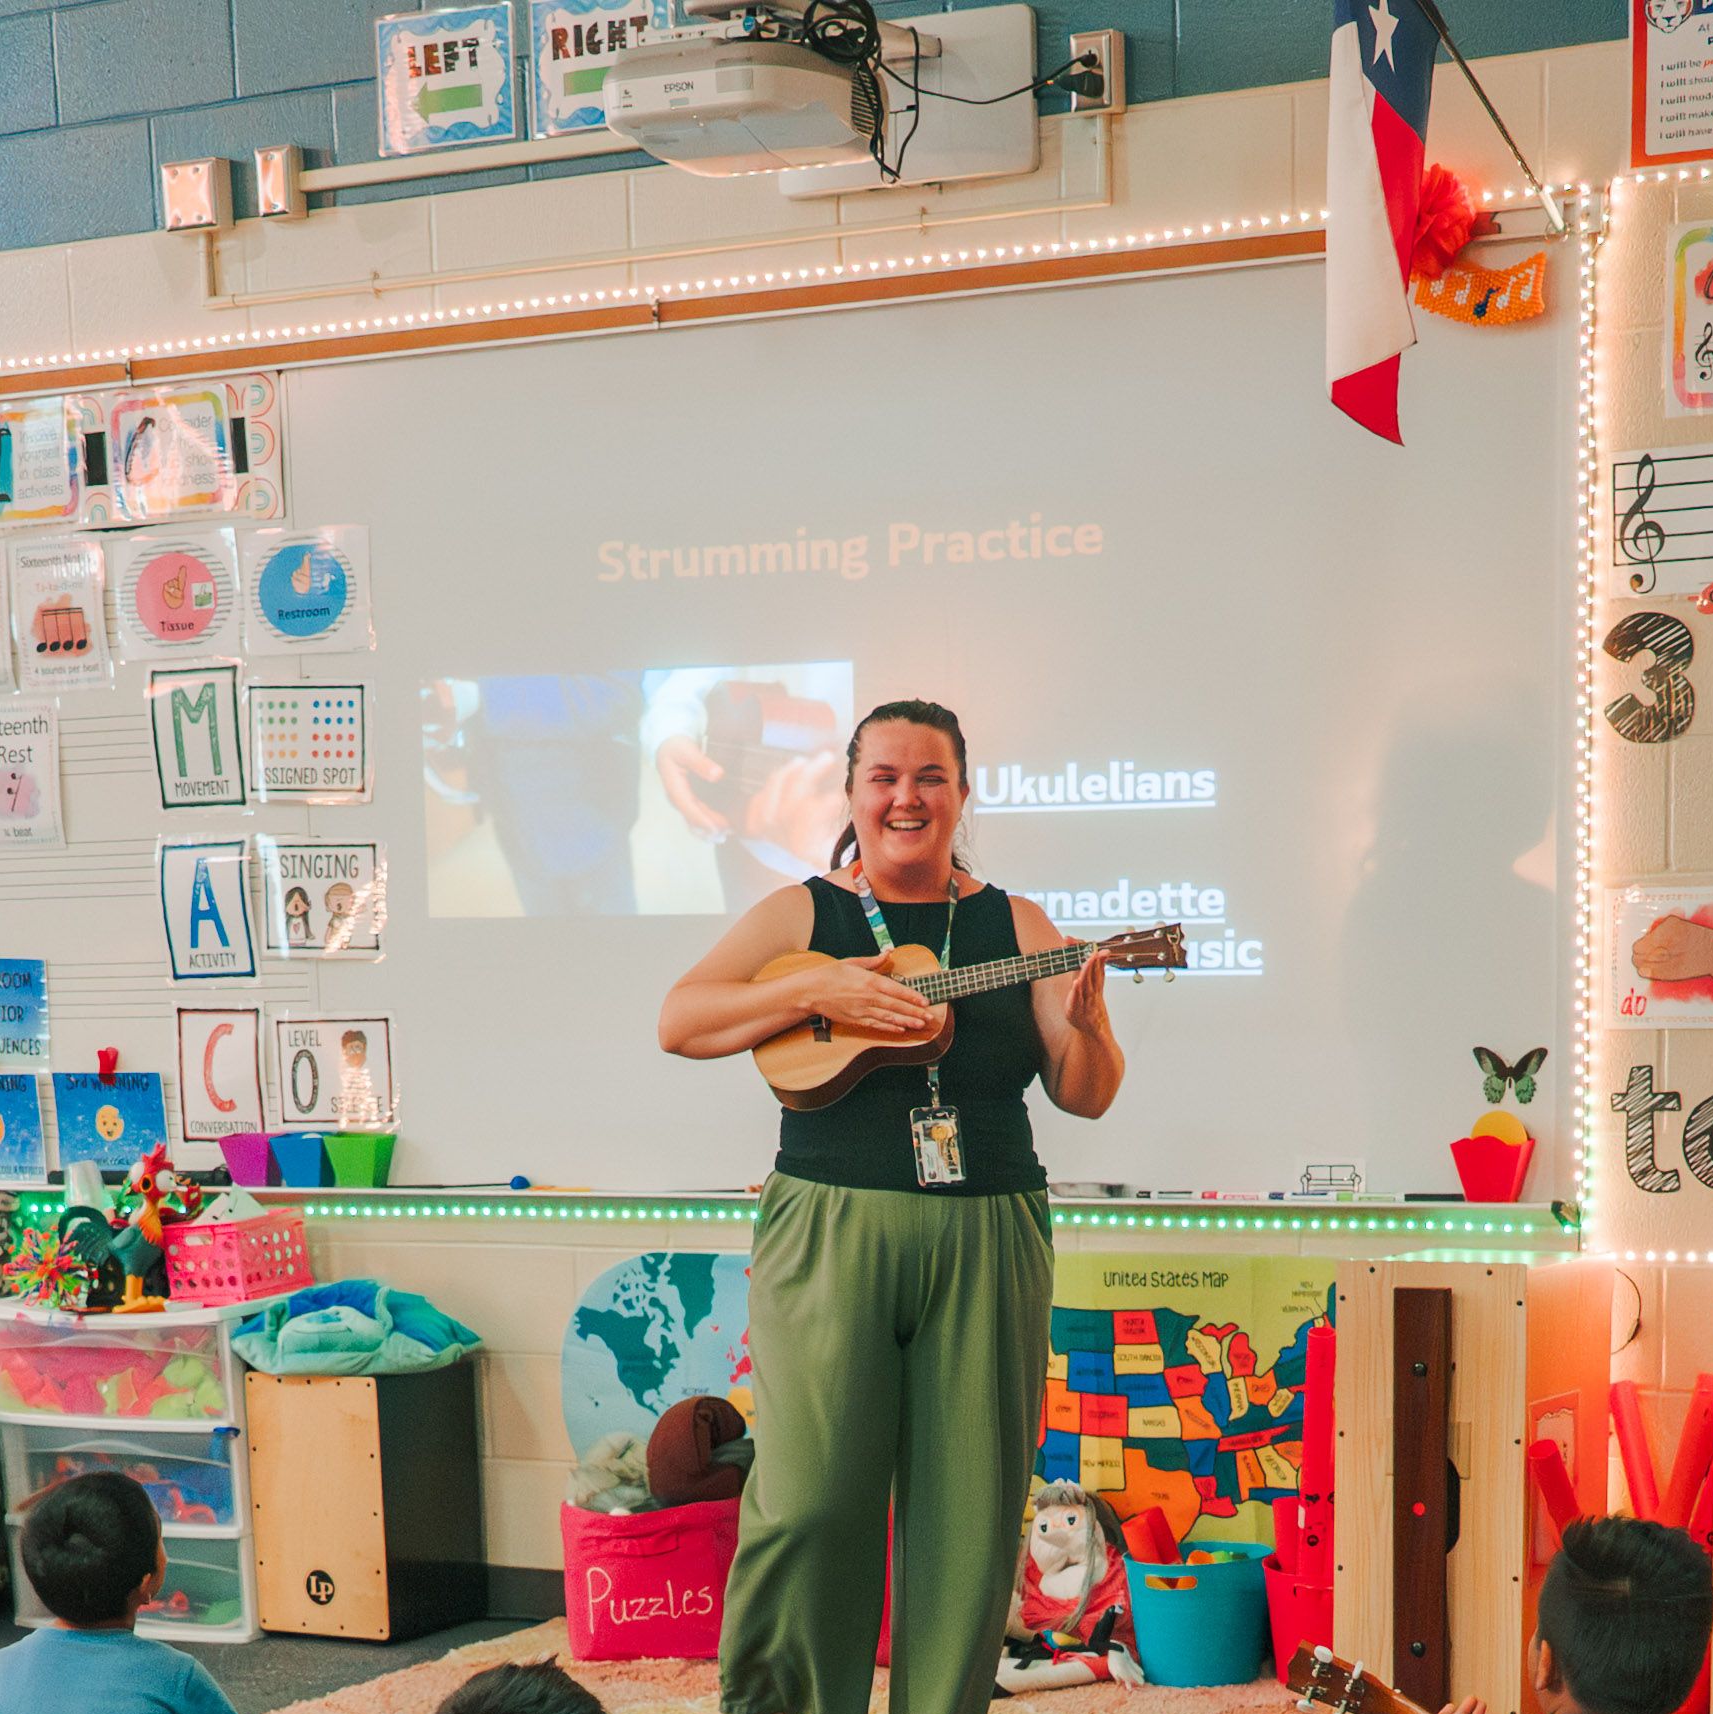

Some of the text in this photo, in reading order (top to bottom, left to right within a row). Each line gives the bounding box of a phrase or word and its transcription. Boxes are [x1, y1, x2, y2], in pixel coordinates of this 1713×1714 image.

[551, 15, 649, 61] RIGHT
[407, 38, 480, 78] LEFT
[1666, 60, 1688, 71] will
[1689, 59, 1702, 68] be
[664, 81, 694, 93] EPSON
[1666, 77, 1688, 88] will
[1666, 94, 1688, 105] will
[1665, 112, 1688, 123] will
[1665, 129, 1688, 140] will
[1688, 126, 1713, 137] have
[32, 464, 61, 480] class
[596, 511, 1104, 583] Strumming Practice
[19, 555, 63, 570] Sixteenth
[278, 604, 331, 622] Restroom
[159, 618, 195, 633] Tissue
[41, 662, 100, 677] sounds per beat
[1603, 611, 1696, 744] 3
[171, 682, 223, 779] M
[262, 766, 357, 787] SSIGNED SPOT
[976, 760, 1217, 806] Ukulelians
[174, 779, 230, 798] MOVEMENT
[11, 826, 33, 838] beat
[279, 854, 360, 880] SINGING
[190, 857, 231, 950] A
[1008, 878, 1226, 918] rnadette
[189, 952, 237, 970] ACTIVITY
[1618, 989, 1649, 1019] do
[287, 1029, 323, 1047] LEVEL
[203, 1022, 238, 1115] C
[65, 1074, 87, 1091] 3rd
[189, 1119, 259, 1136] CONVERSATION
[1103, 1270, 1230, 1290] United States Map
[309, 1575, 334, 1602] LP
[584, 1565, 716, 1630] Puzzles
